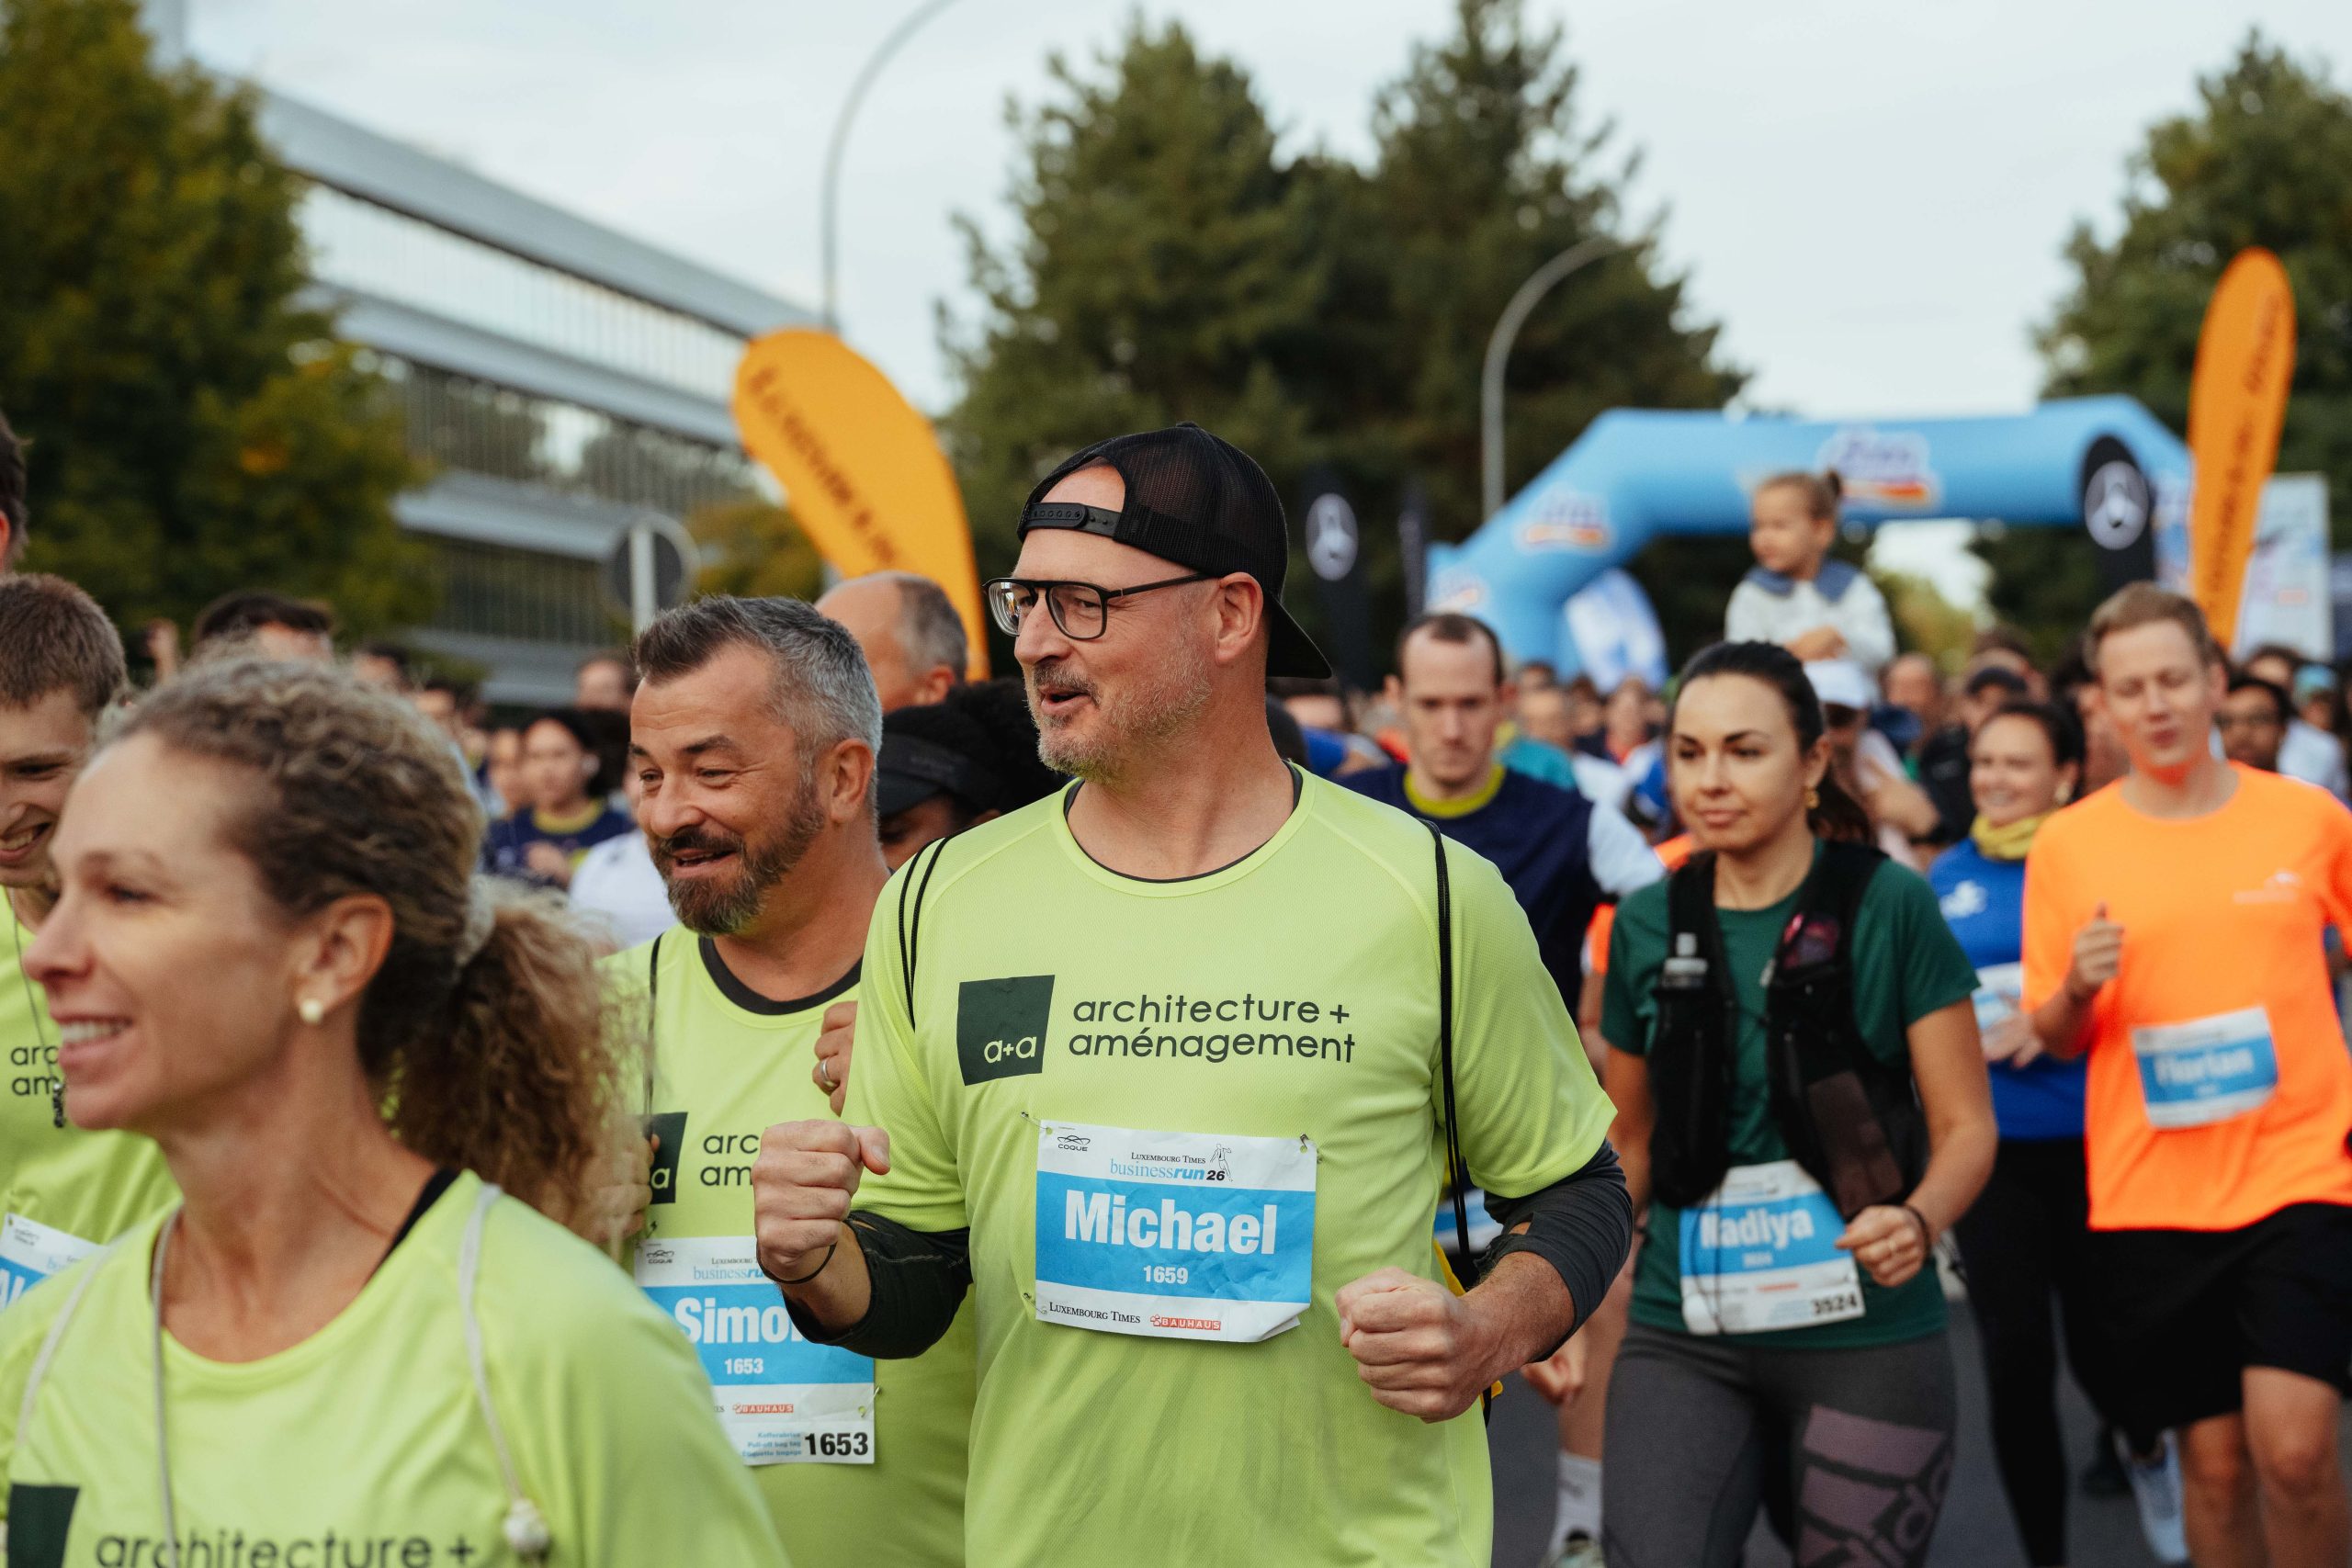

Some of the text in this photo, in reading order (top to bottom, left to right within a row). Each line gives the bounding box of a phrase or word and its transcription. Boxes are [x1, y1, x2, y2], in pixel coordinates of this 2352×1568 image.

[1073, 994, 1350, 1023] architecture +
[983, 1035, 1037, 1064] a+a
[1069, 1028, 1355, 1063] aménagement
[1057, 1144, 1088, 1152] COQUE
[1131, 1151, 1206, 1164] LUXEMBOURG TIMES
[1205, 1169, 1226, 1181] 26
[1065, 1189, 1277, 1255] Michael
[1701, 1208, 1815, 1250] Nadiya
[1143, 1265, 1189, 1285] 1659
[1049, 1302, 1141, 1324] LUXEMBOURG TIMES
[1161, 1316, 1221, 1330] BAUHAUS
[724, 1358, 763, 1375] 1653
[741, 1404, 794, 1414] BAUHAUS
[805, 1431, 868, 1456] 1653
